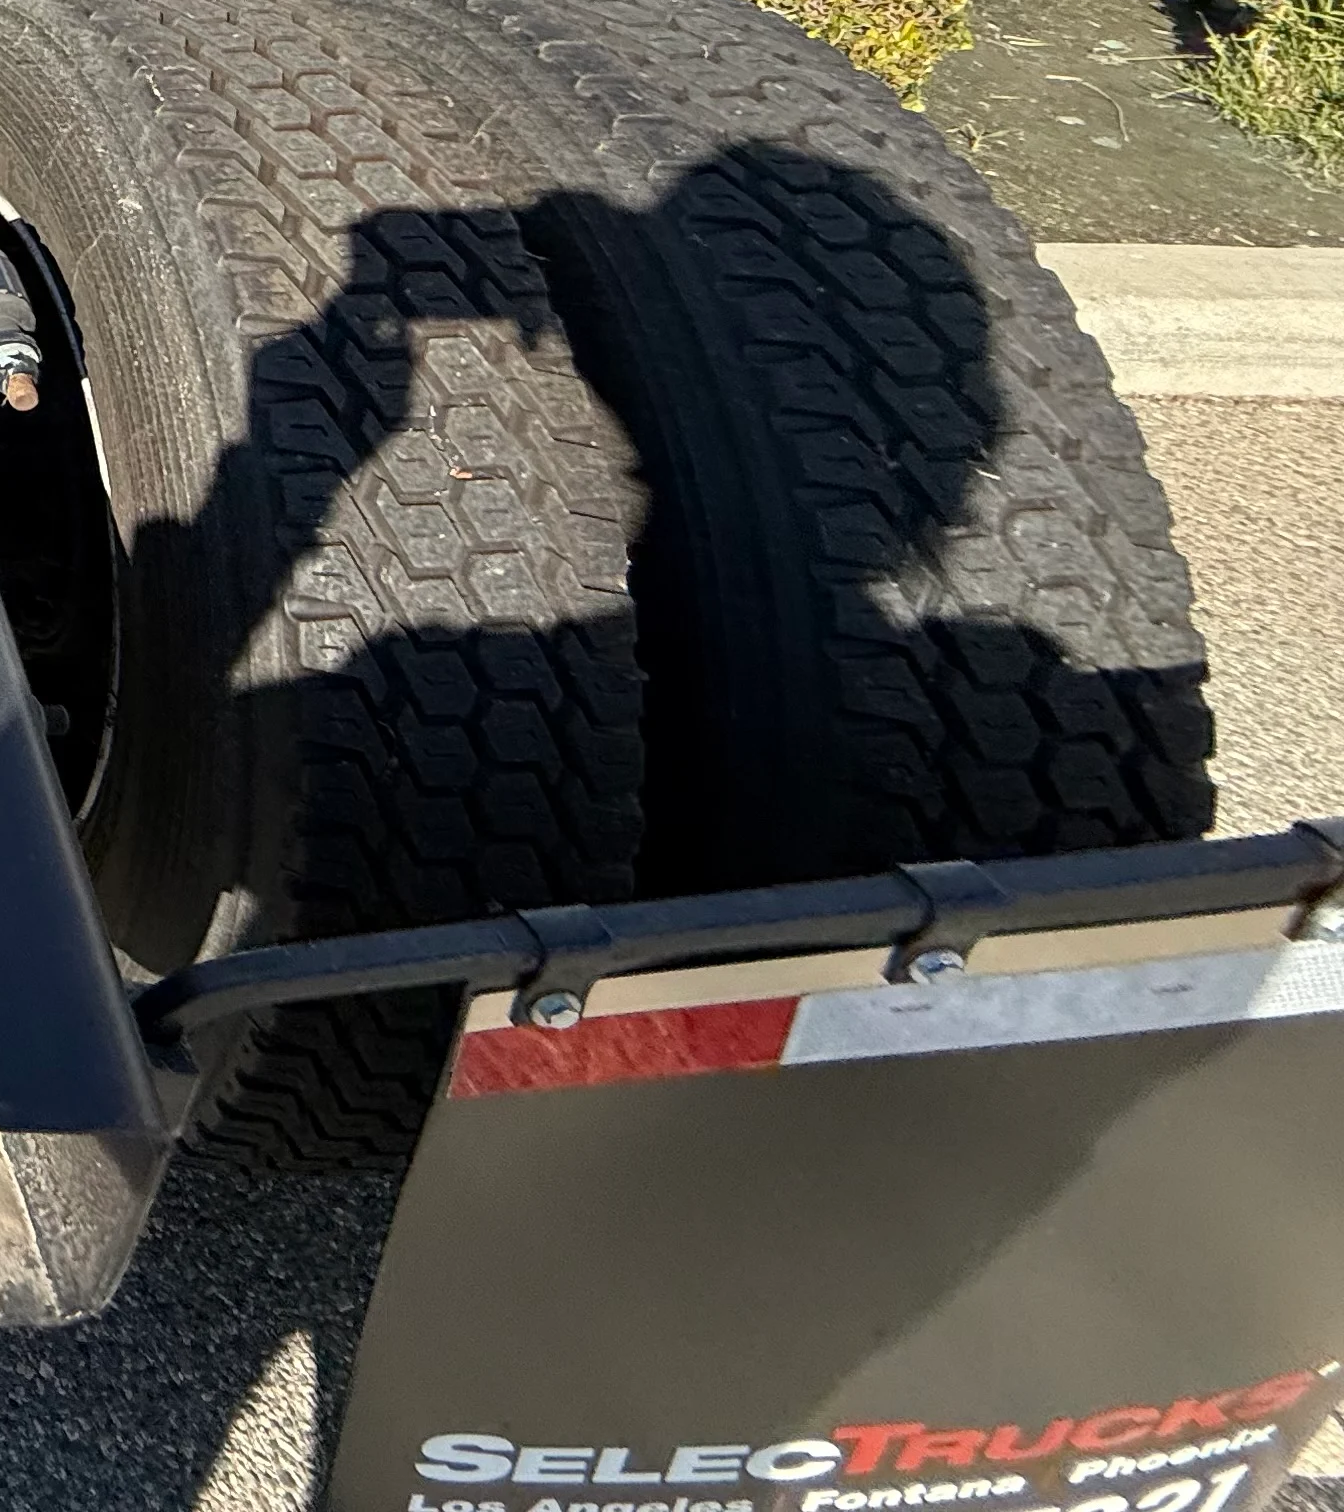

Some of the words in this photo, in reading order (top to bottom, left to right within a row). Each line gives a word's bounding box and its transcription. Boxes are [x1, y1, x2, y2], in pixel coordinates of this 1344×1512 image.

[414, 1369, 1314, 1483] SELECTRUCKS
[800, 1474, 1027, 1512] Fontana
[1068, 1424, 1279, 1484] Phoenix
